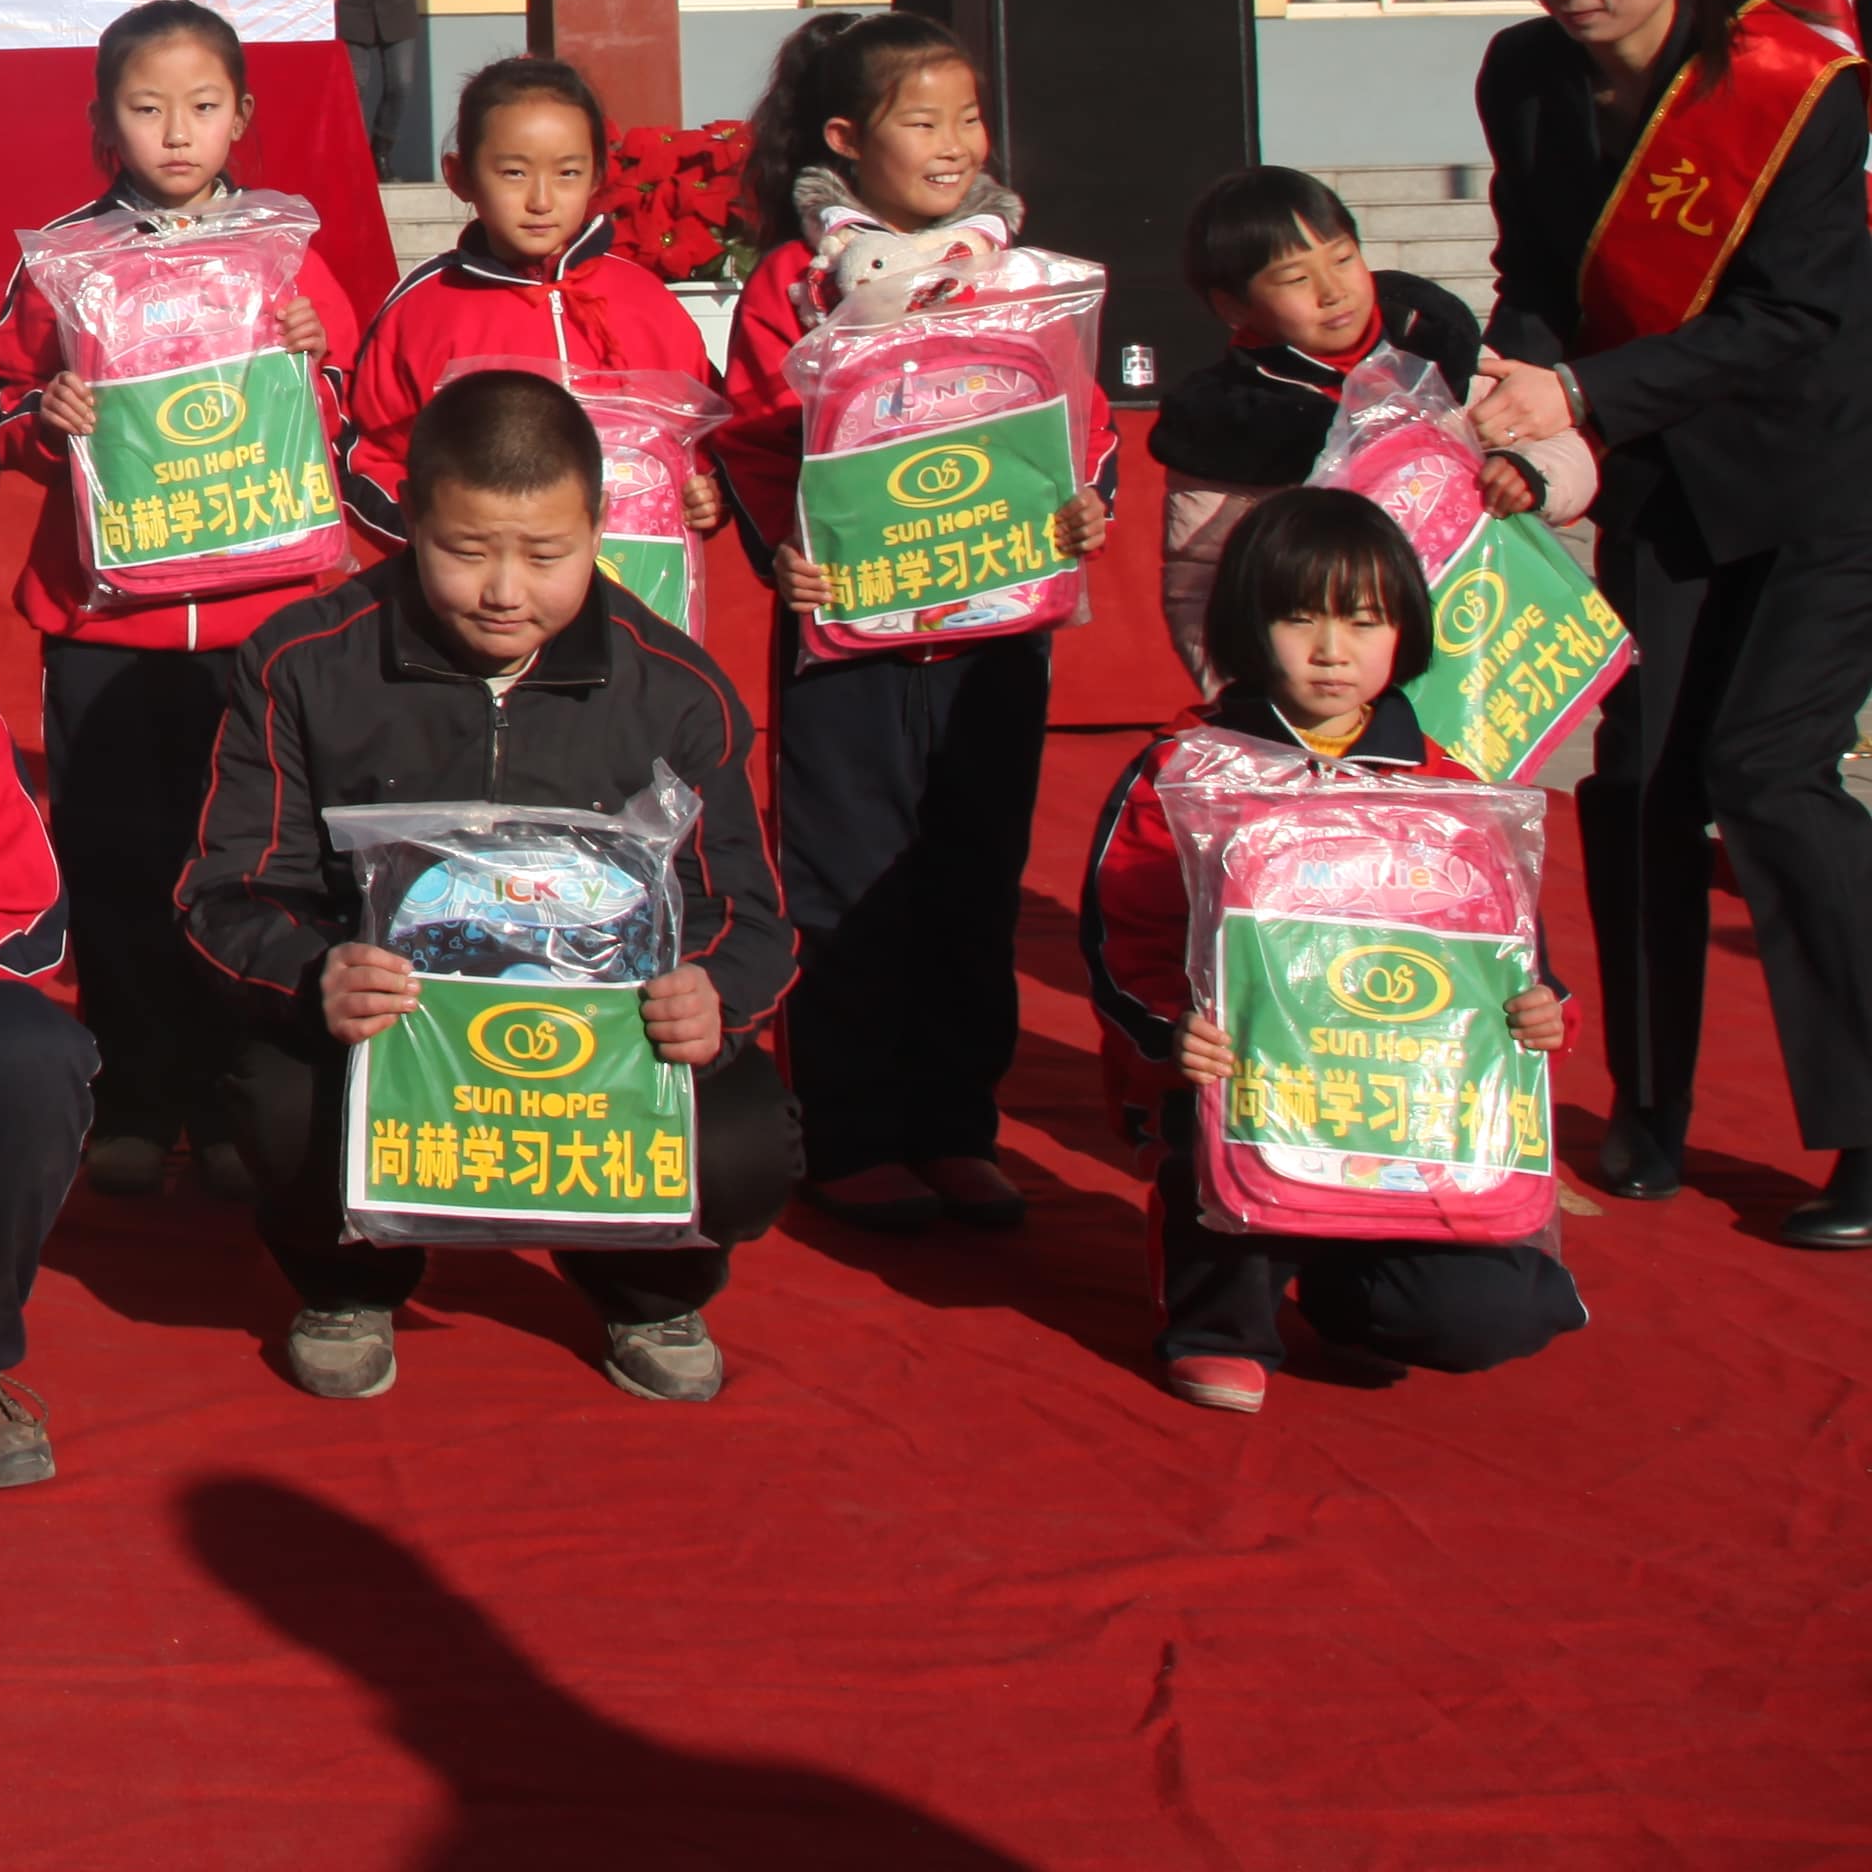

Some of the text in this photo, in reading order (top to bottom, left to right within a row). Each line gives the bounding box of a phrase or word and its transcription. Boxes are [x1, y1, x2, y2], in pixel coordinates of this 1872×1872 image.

[1646, 157, 1714, 237] 礼
[205, 441, 265, 474] HOPE
[98, 462, 335, 554] 尚赫学习大礼包
[937, 499, 1009, 534] HOPE
[1490, 603, 1549, 660] HOPE
[520, 1090, 610, 1120] HOPE
[371, 1119, 688, 1199] 尚赫学习大礼包
